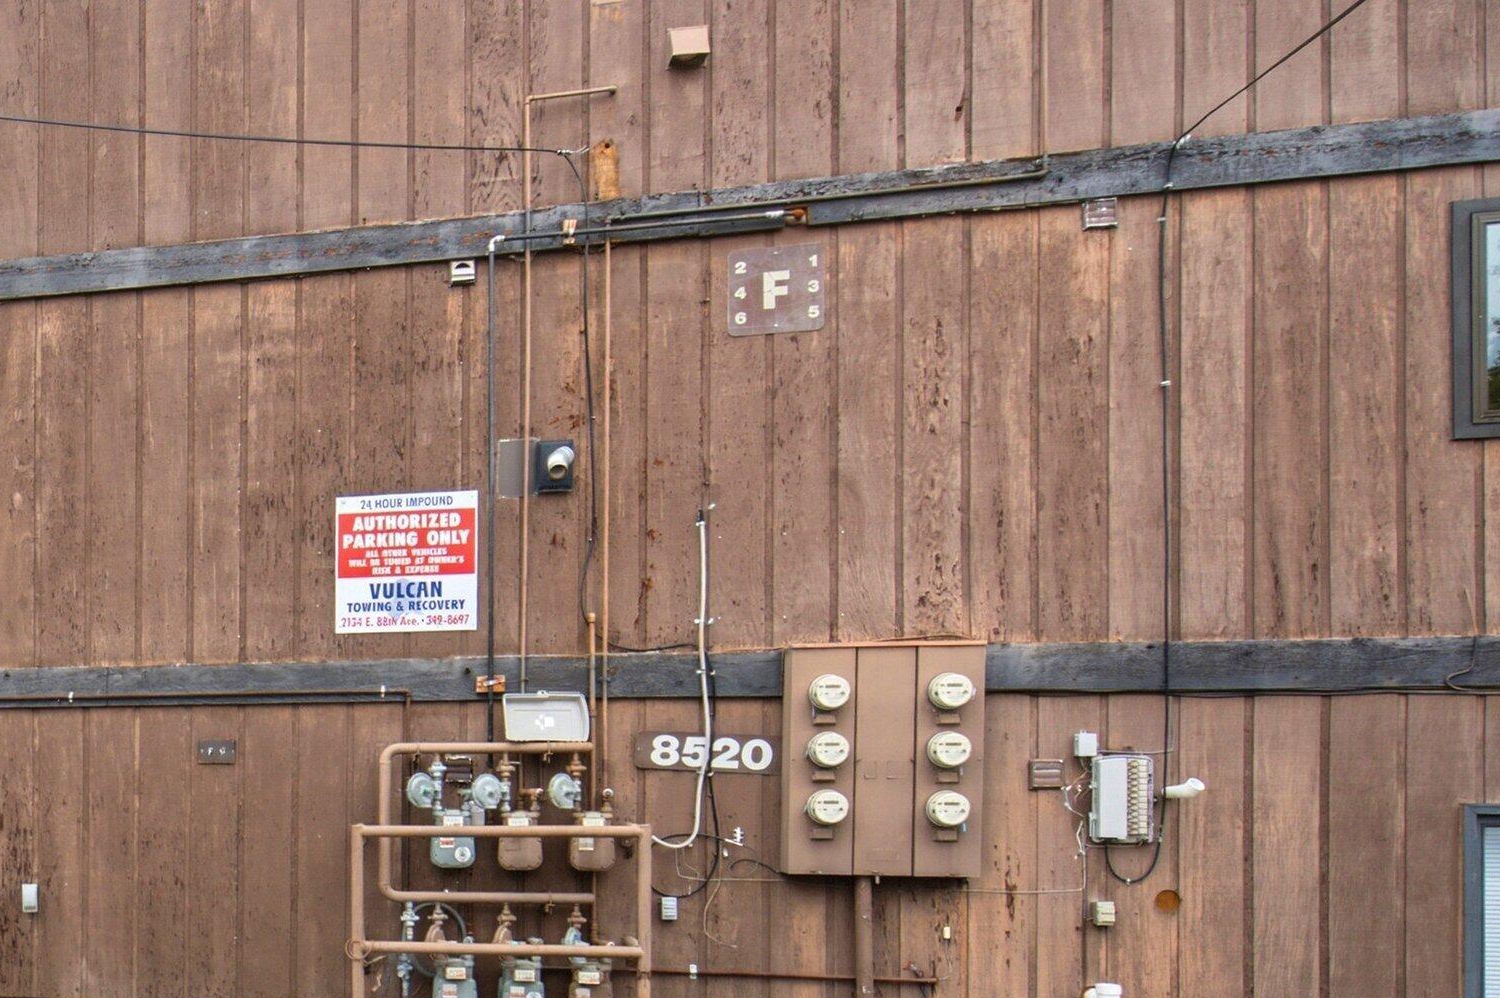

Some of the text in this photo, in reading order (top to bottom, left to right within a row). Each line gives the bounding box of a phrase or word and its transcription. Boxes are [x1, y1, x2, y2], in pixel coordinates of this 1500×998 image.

[735, 261, 747, 274] 2
[808, 254, 818, 268] 1
[734, 286, 747, 300] 4
[762, 269, 790, 310] F
[807, 279, 819, 293] 3
[734, 311, 747, 325] 6
[807, 304, 820, 318] 5
[360, 495, 454, 510] 24 HOUR IMPOUND
[352, 512, 462, 532] AUTHORIZED
[342, 528, 470, 549] PARKING ONLY
[411, 546, 448, 556] VEHICLES
[384, 556, 412, 566] TOWED
[369, 580, 443, 600] VULCAN
[346, 598, 466, 613] TOWING & RECOVERY
[365, 616, 374, 627] E.
[650, 734, 773, 771] 8520
